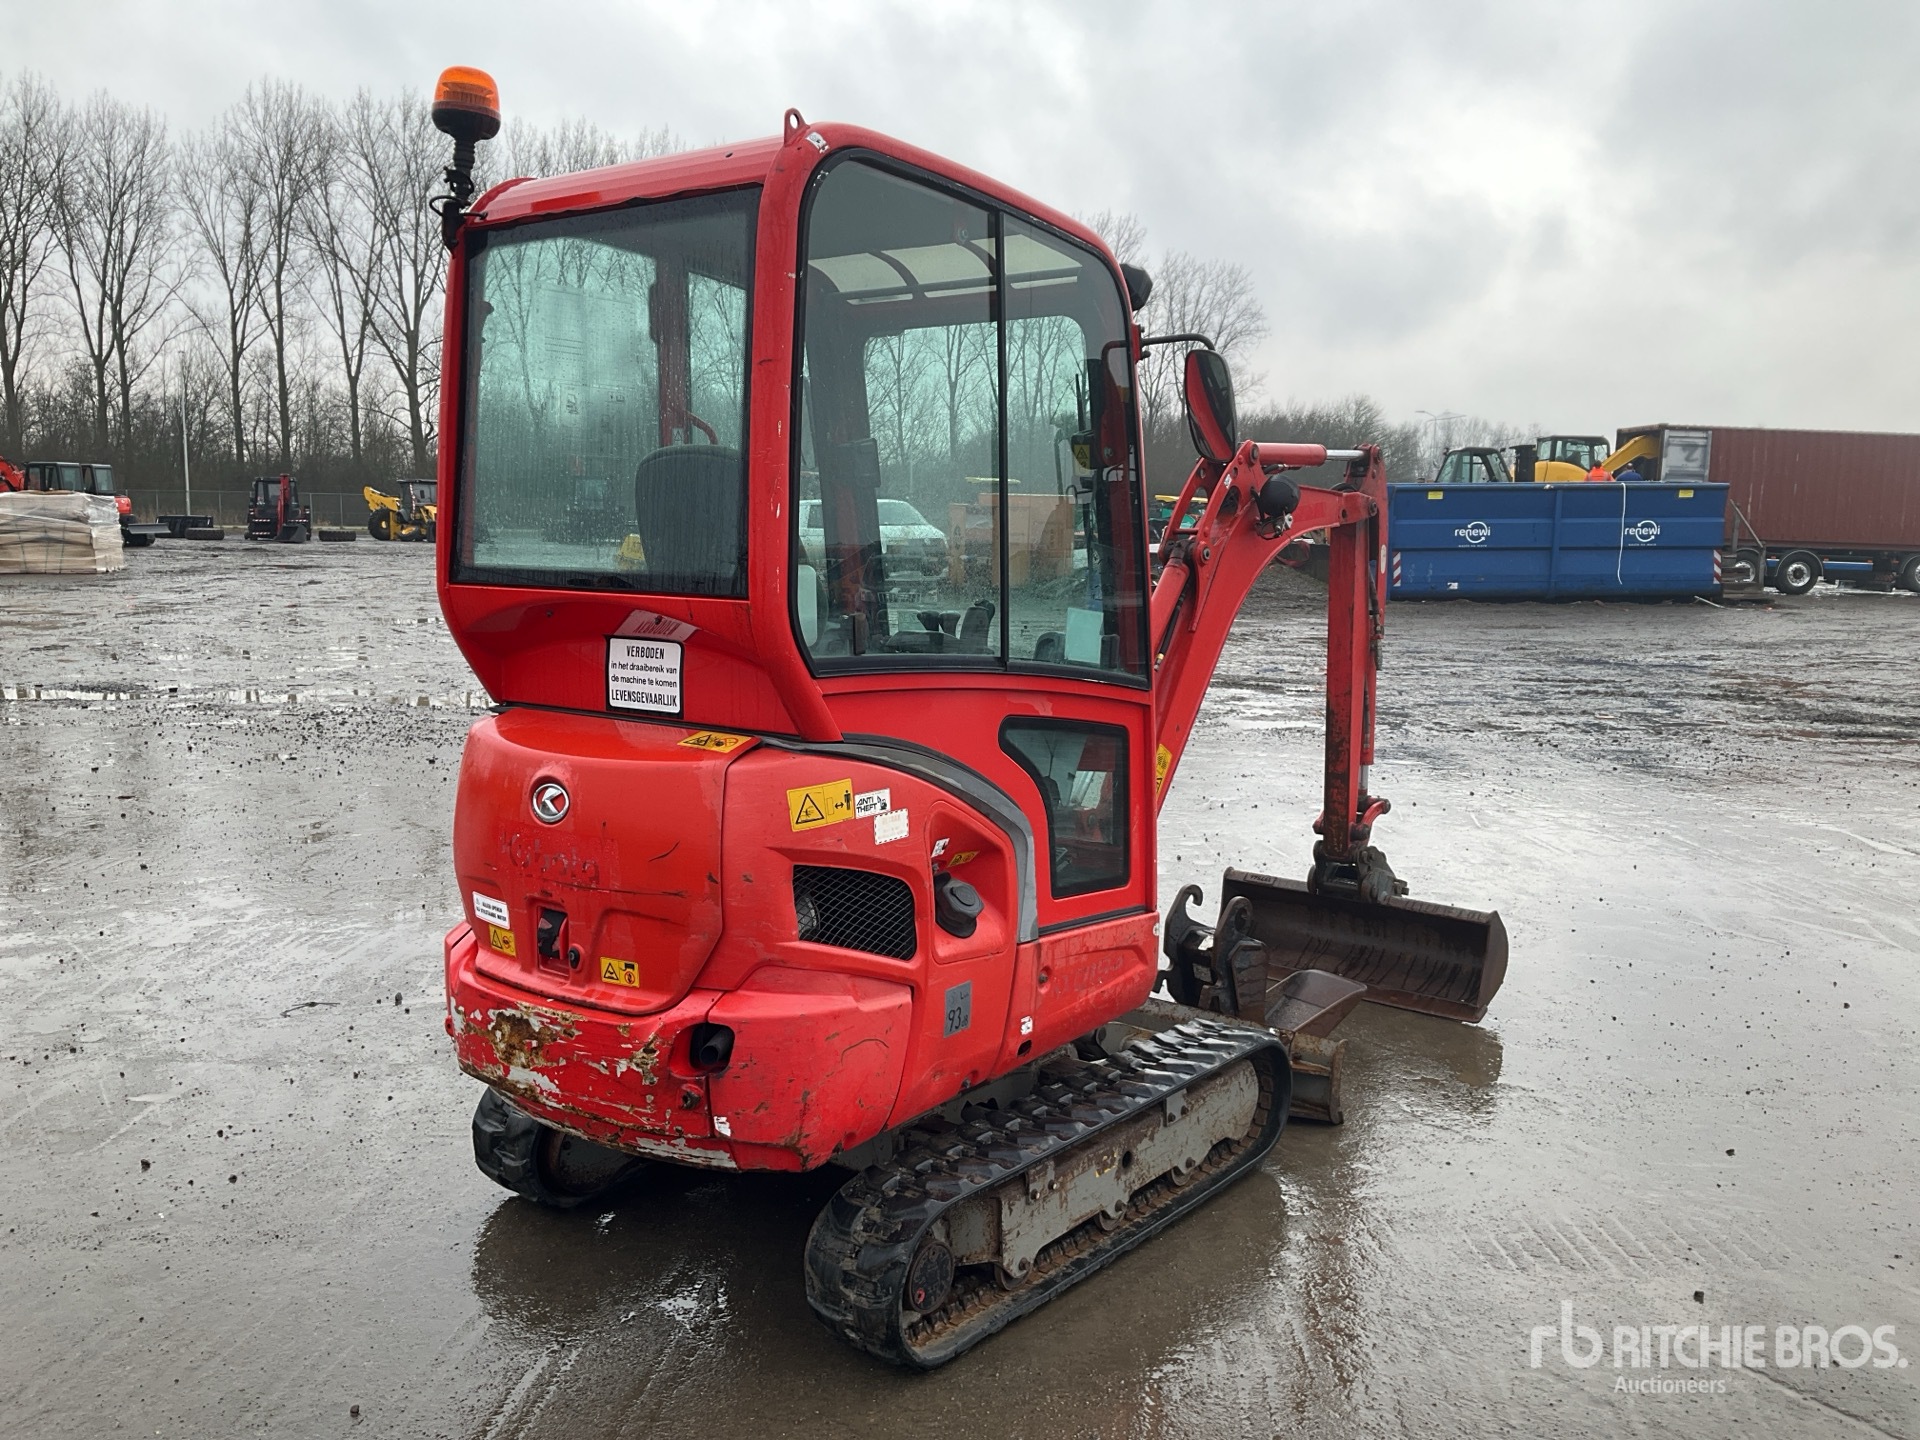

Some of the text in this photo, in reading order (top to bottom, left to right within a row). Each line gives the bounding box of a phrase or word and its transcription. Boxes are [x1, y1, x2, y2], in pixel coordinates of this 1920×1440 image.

[1454, 525, 1491, 538] renewi
[1624, 524, 1661, 537] renewi
[626, 645, 665, 660] VERBODEN
[611, 661, 618, 669] in
[618, 661, 629, 671] het
[629, 662, 665, 673] draaibereik
[611, 674, 677, 688] de machine te komen
[611, 689, 678, 707] LEVENSGEVAARLIJK
[856, 796, 874, 806] ANTI
[856, 803, 878, 813] THEFT
[948, 1006, 962, 1032] 93
